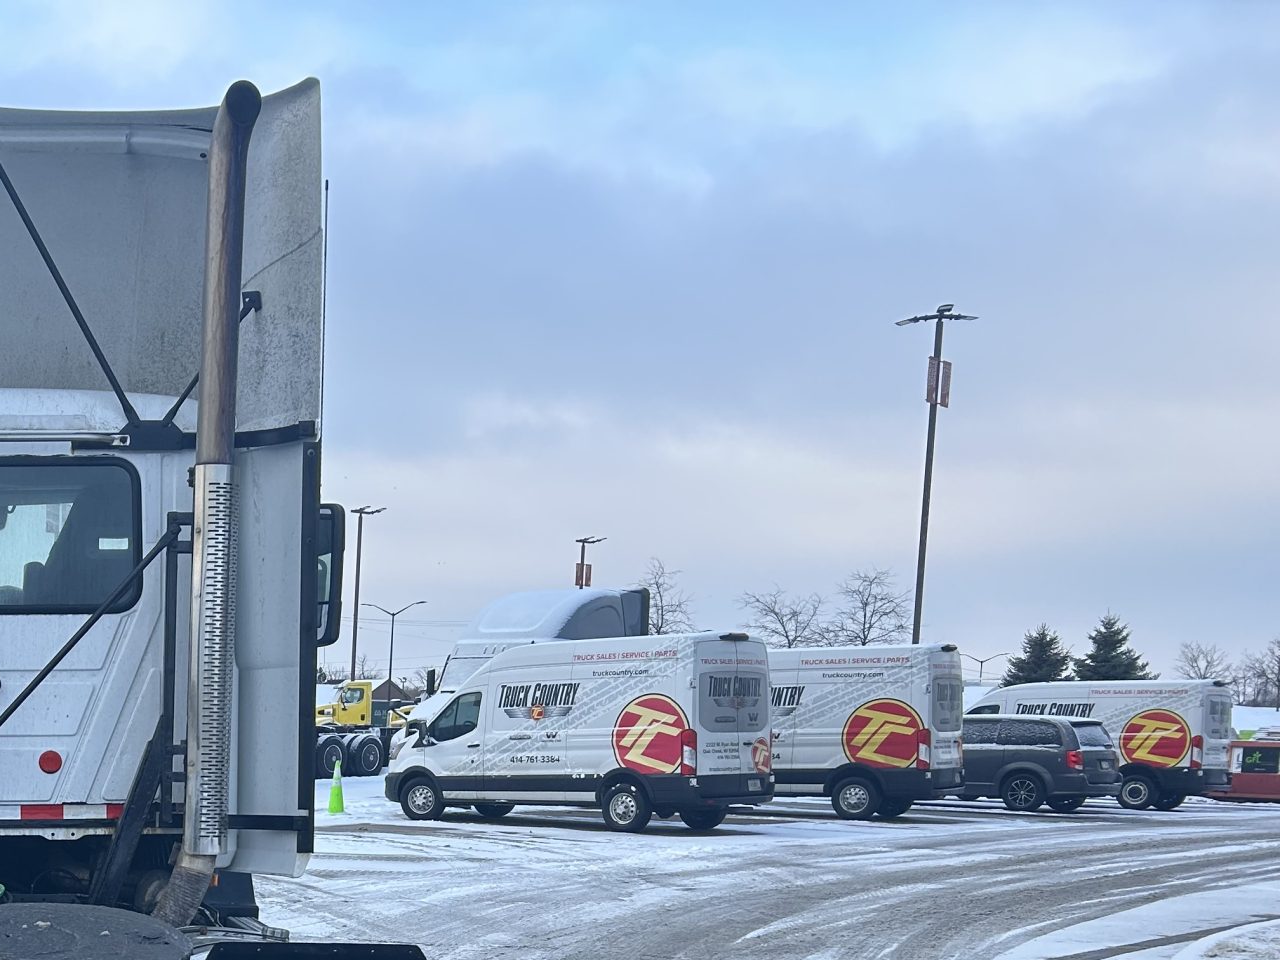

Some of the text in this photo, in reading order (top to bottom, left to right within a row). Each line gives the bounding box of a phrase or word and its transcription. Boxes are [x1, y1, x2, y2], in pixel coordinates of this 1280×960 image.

[573, 649, 677, 662] TRUCK SALES SERVICE PARTS
[886, 656, 910, 664] PARTS
[592, 668, 649, 677] truckcountry.com
[822, 671, 884, 679] truckcountry.com
[709, 675, 761, 697] TRUCK COUNTRY
[498, 682, 580, 708] TRUCK COUNTRY
[510, 755, 560, 764] 414-761-3384
